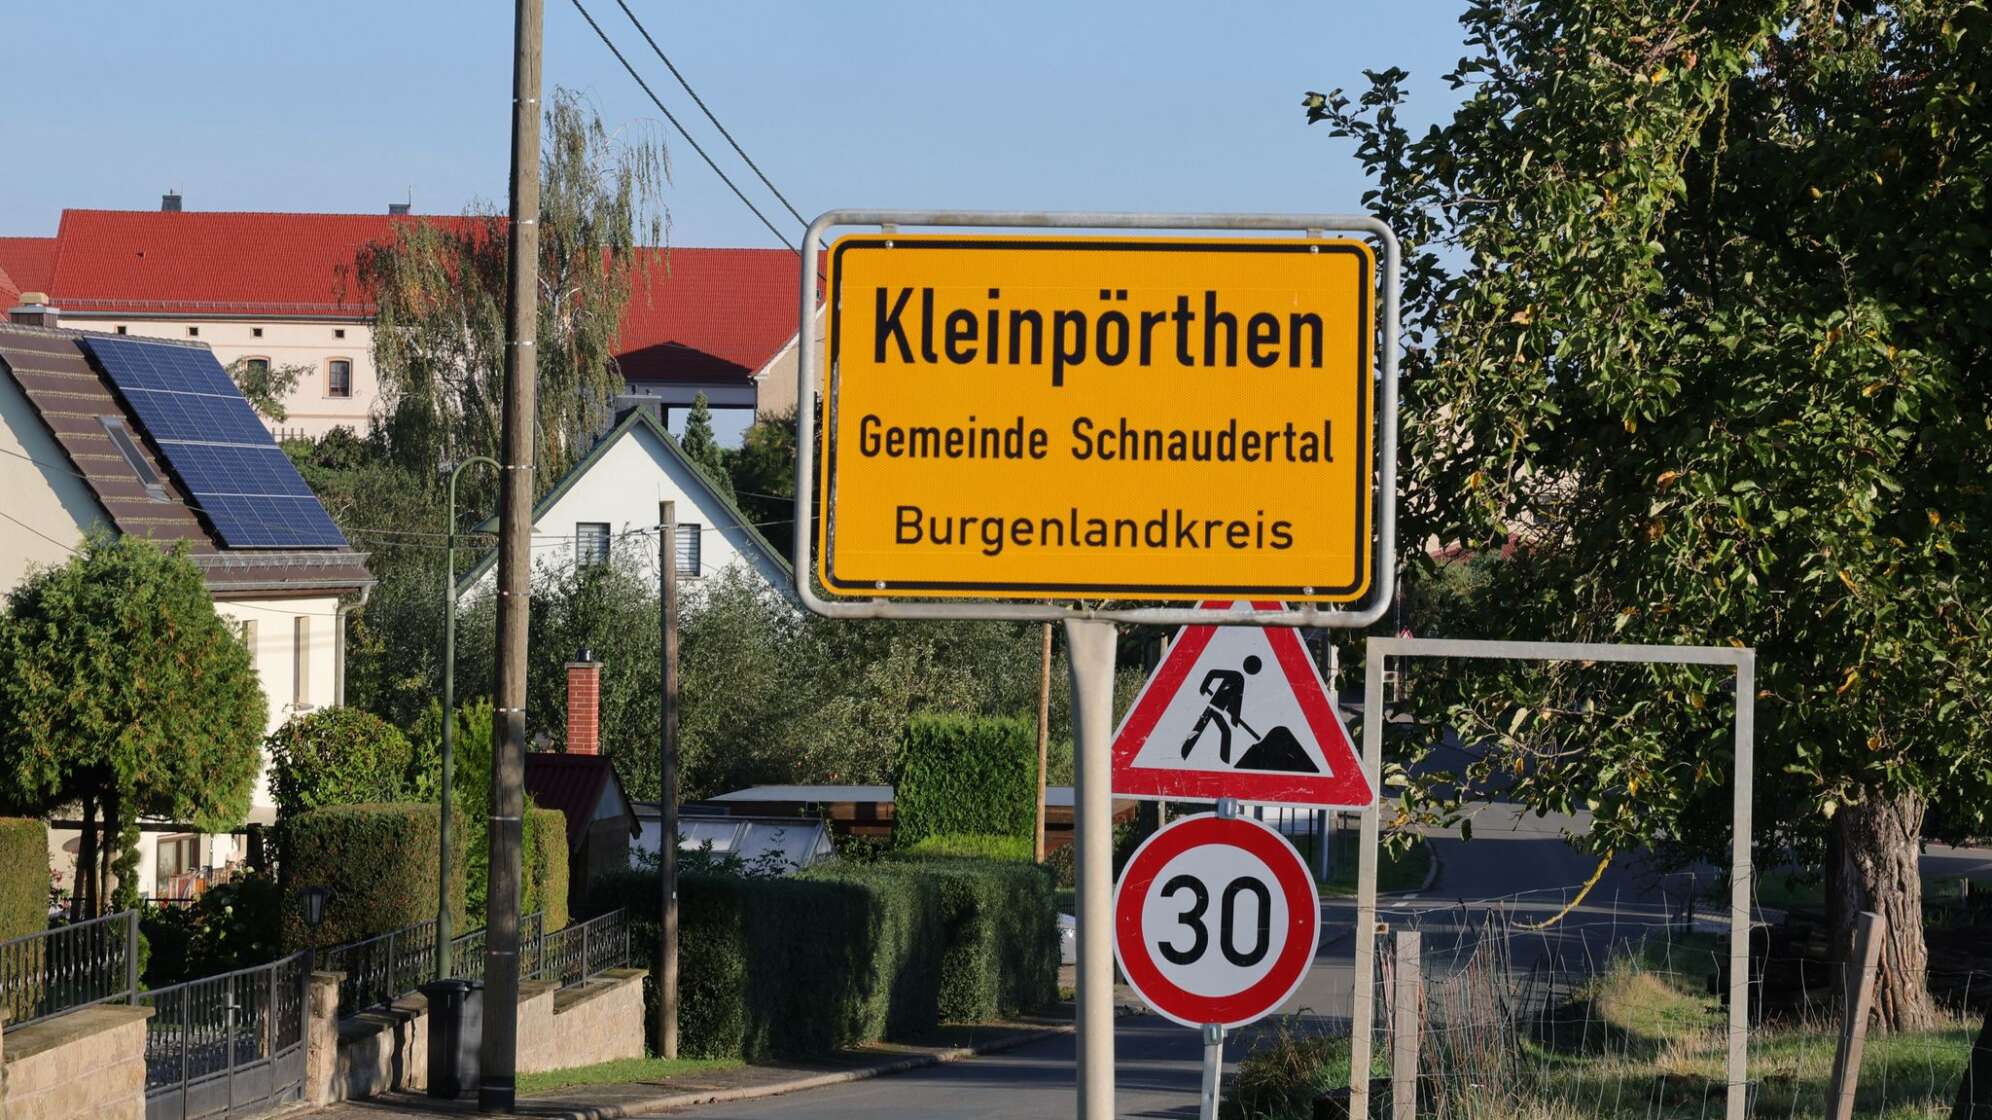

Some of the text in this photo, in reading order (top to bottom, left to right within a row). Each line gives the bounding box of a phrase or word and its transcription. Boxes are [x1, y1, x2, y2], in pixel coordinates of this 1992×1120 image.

[874, 287, 1323, 387] Kleinpörthen
[860, 414, 1333, 463] Gemeinde Schnaudertal
[895, 505, 1294, 556] Burgenlandkreis
[1158, 874, 1271, 967] 30
